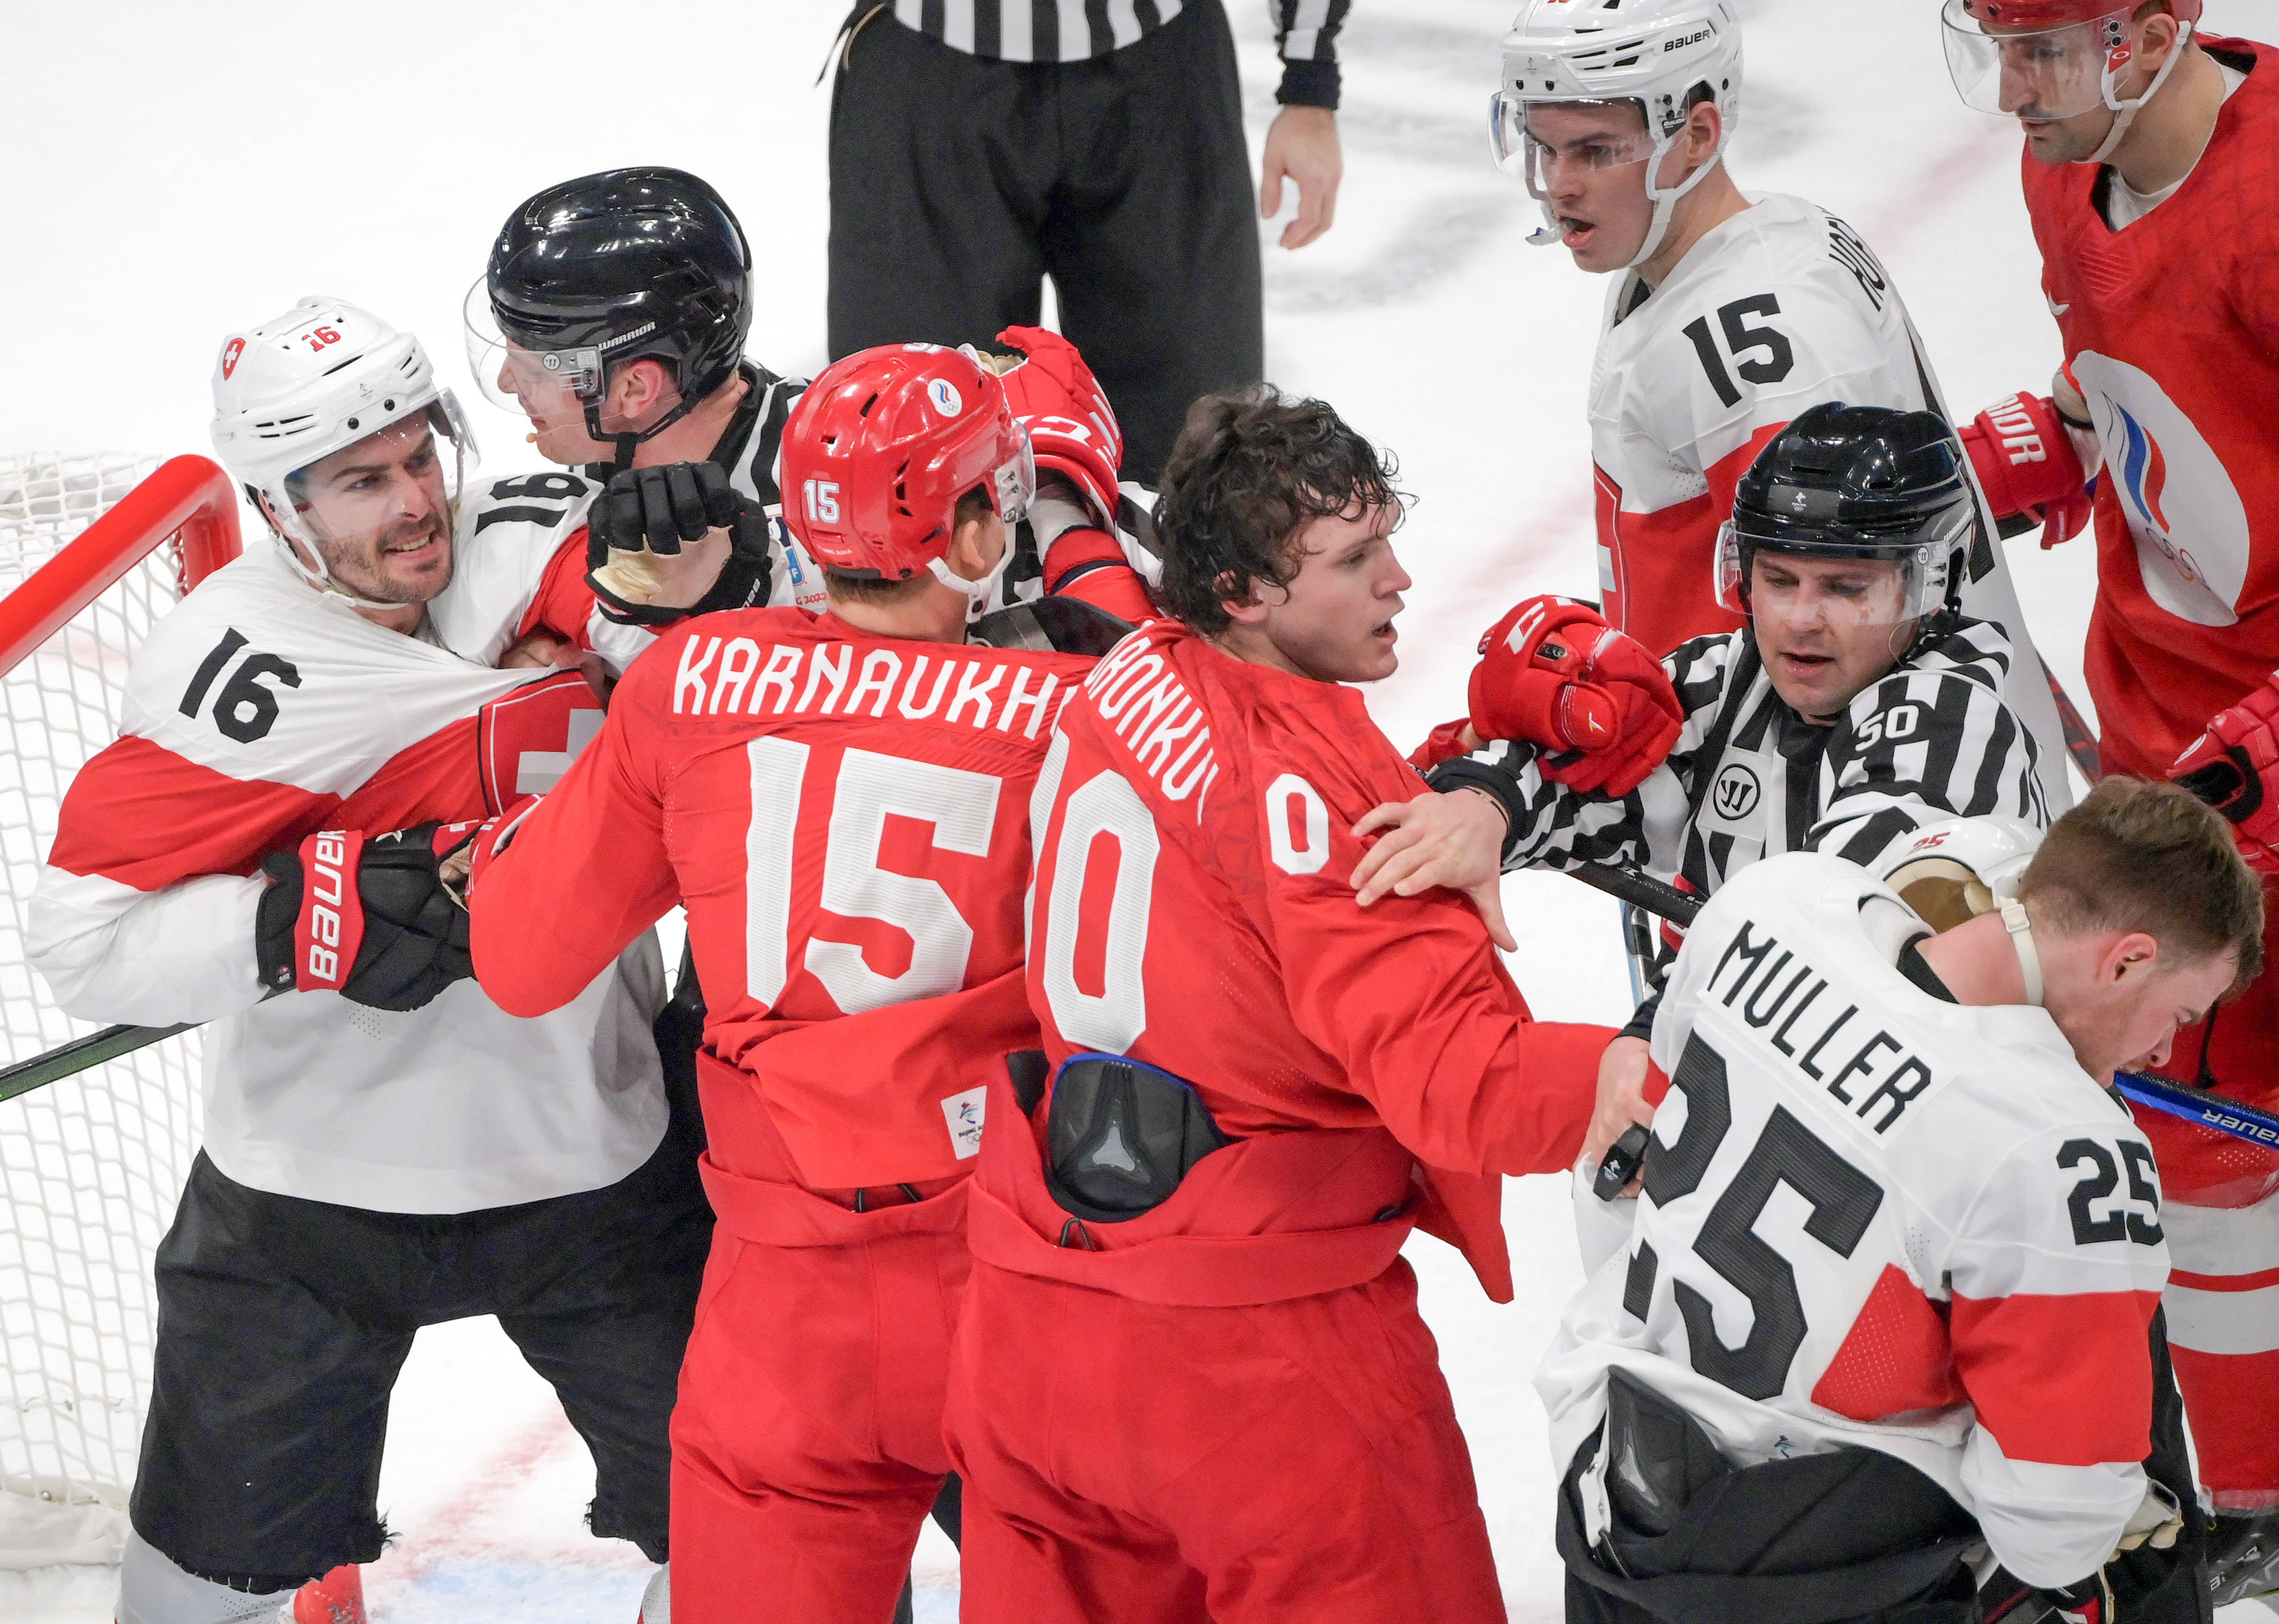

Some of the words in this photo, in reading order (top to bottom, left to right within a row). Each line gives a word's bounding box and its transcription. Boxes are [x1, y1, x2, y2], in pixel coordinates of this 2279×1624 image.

[1664, 29, 1710, 52] BAUER
[302, 326, 341, 352] 16
[598, 321, 656, 351] WARRIOR
[1682, 293, 1794, 408] 15
[475, 472, 589, 537] 16
[804, 479, 840, 524] 15
[178, 627, 303, 744] 16
[1855, 705, 1919, 752] 50
[746, 734, 1002, 1015] 15
[1905, 832, 1950, 857] 25
[309, 829, 347, 982] BAUER
[1707, 920, 1932, 1135] MULLER
[2202, 1109, 2279, 1145] AUER
[1623, 1026, 1885, 1401] 25
[2056, 1137, 2165, 1246] 25
